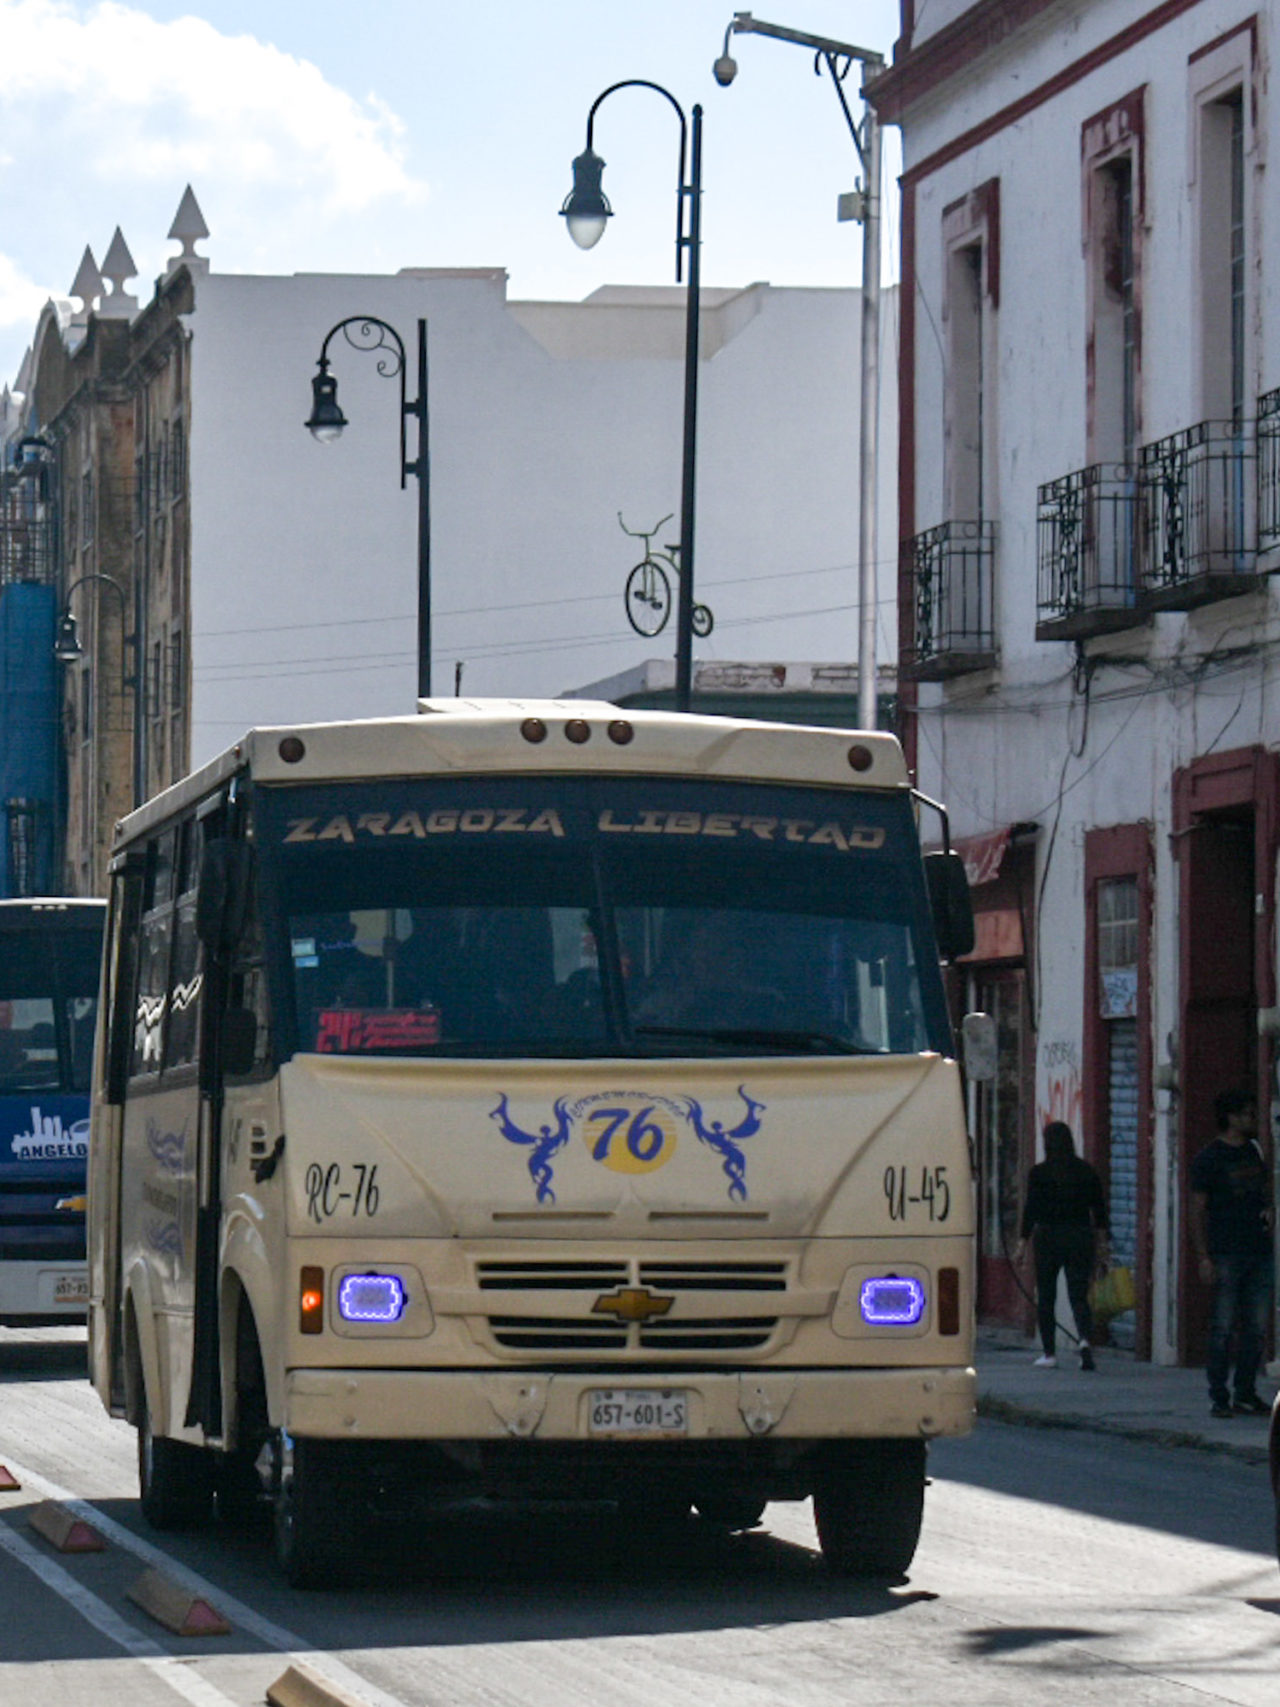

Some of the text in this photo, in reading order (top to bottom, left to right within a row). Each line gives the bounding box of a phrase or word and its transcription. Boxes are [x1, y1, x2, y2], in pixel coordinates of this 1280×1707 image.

[282, 808, 886, 851] ZARAGOZA LIBERTAD
[588, 1105, 664, 1162] 76
[305, 1162, 380, 1224] RC-76
[883, 1165, 950, 1222] U-45
[592, 1403, 684, 1425] 657-601-S
